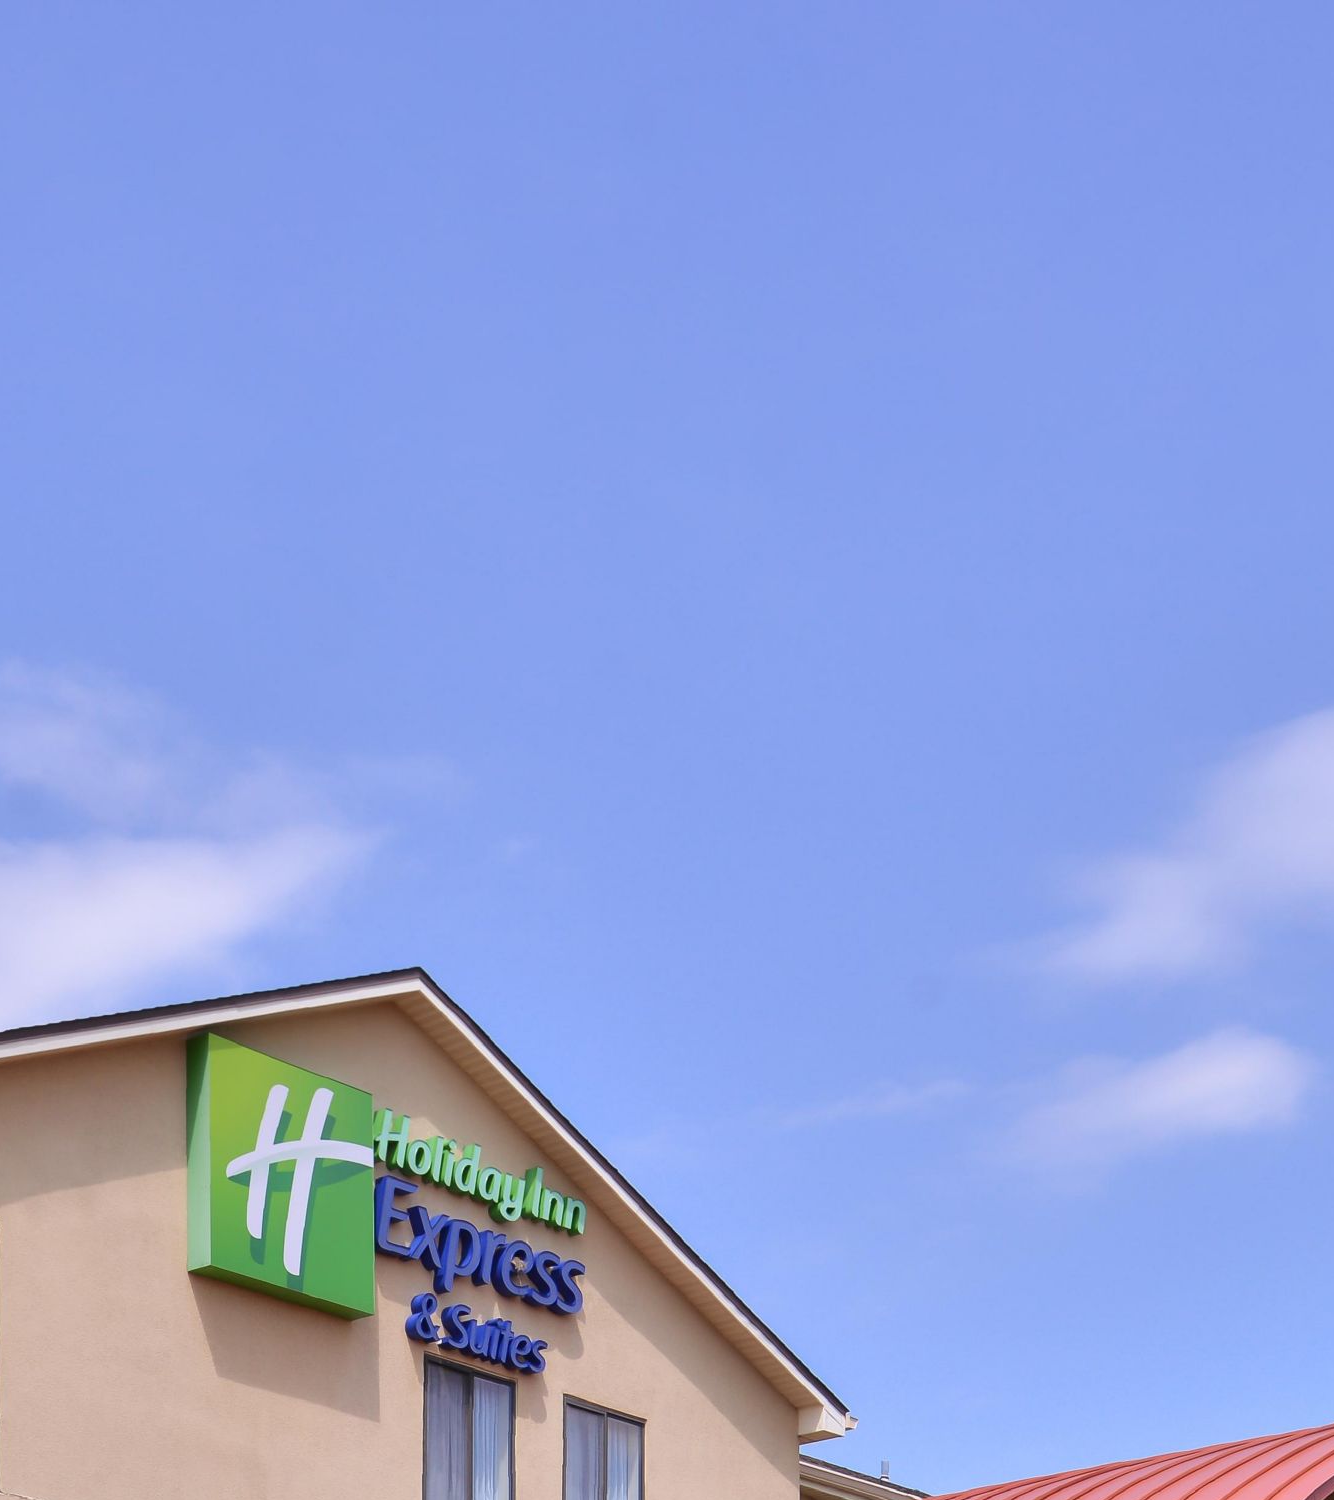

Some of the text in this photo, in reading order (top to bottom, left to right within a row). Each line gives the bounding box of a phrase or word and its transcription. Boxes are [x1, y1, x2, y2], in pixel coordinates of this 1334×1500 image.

[373, 1107, 587, 1236] Holiday Inn
[374, 1175, 586, 1315] Express
[405, 1293, 549, 1374] & Suites
